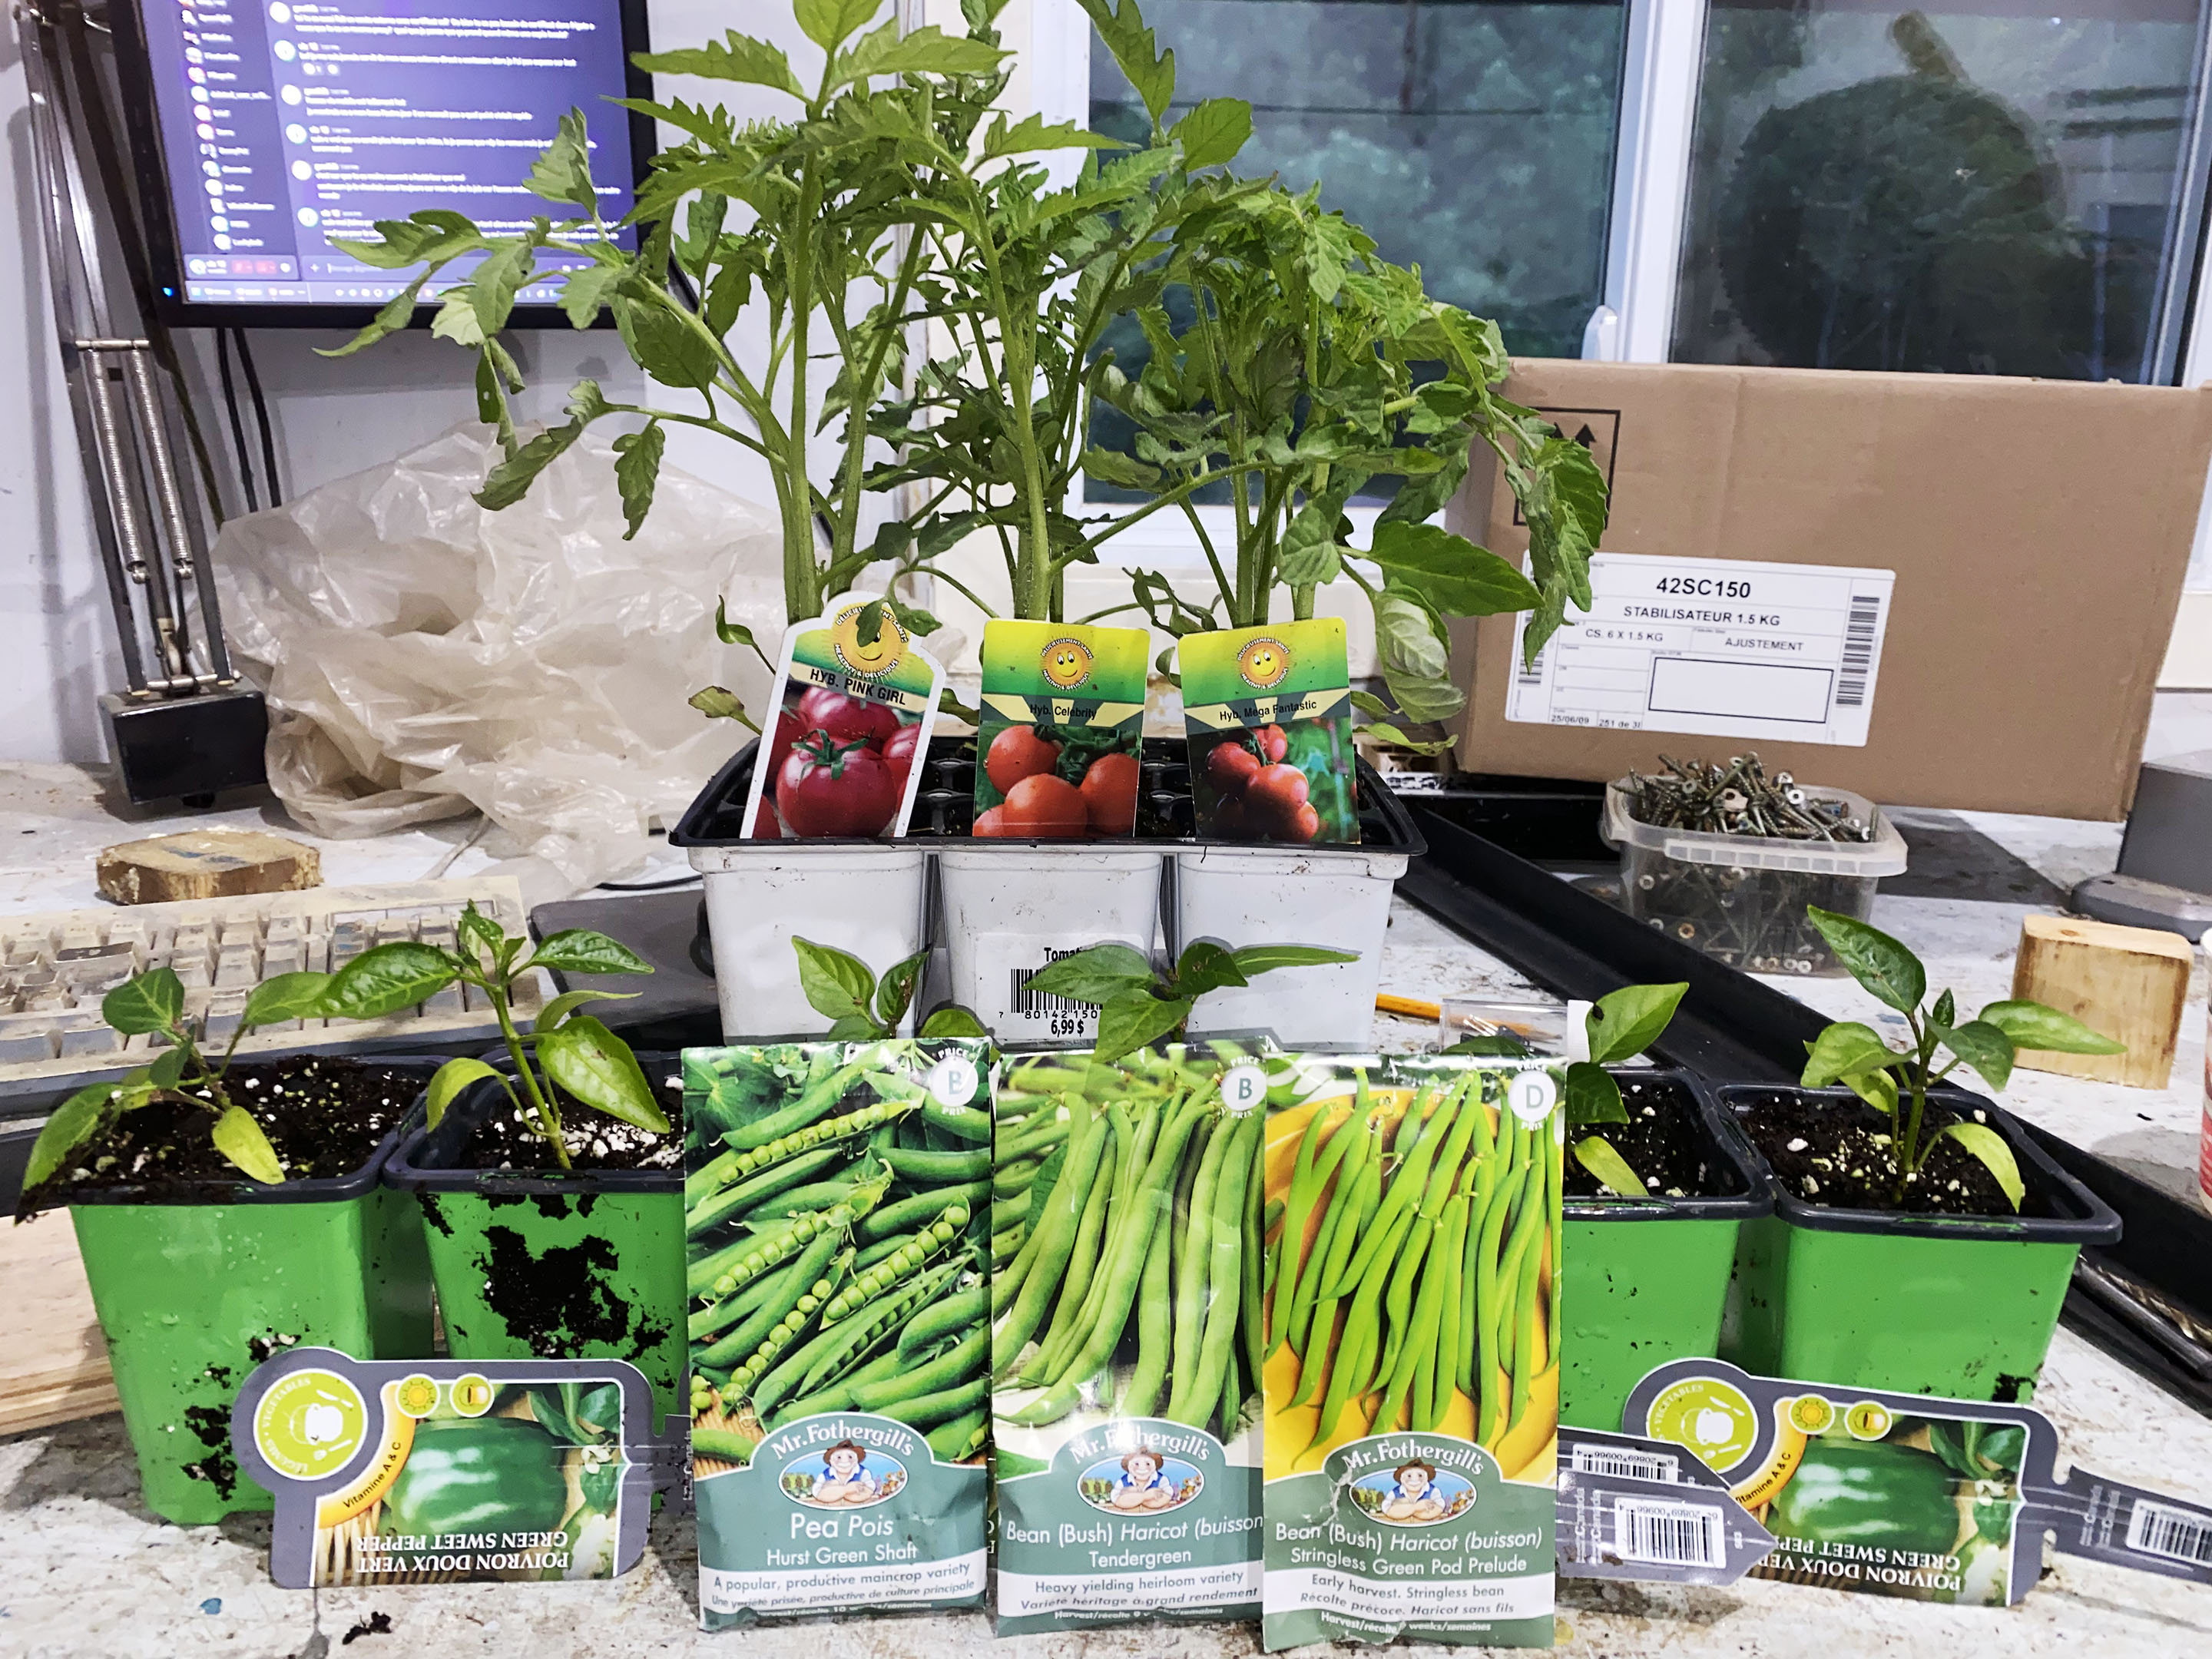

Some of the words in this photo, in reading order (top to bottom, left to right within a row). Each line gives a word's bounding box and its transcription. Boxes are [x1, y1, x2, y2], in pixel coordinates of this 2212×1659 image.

[1656, 577, 1752, 598] 42SC150
[1623, 605, 1732, 623] STABILISATEUR
[1737, 614, 1756, 624] 1.5
[1759, 615, 1780, 626] KG
[1585, 628, 1604, 638] CS.
[1608, 630, 1614, 638] 6
[1618, 631, 1624, 639] X
[1629, 631, 1643, 641] 1.5
[1647, 632, 1663, 642] KG
[1725, 637, 1804, 651] AJUSTEMENT
[834, 643, 856, 673] HEALTHY
[864, 658, 899, 678] DELICIOUS
[810, 668, 839, 687] HYB.
[844, 677, 875, 697] PINK
[877, 687, 906, 705] GIRL
[1029, 704, 1051, 717] Hyb.
[1054, 705, 1097, 720] Celebrity
[1220, 709, 1241, 721] Hyb.
[1244, 707, 1270, 719] Mega
[1273, 700, 1317, 714] Fantastic
[1551, 714, 1589, 724] 25/06/09
[1025, 1010, 1068, 1019] 80142
[1074, 1010, 1098, 1018] 150
[1051, 1019, 1075, 1038] 6,99
[1077, 1018, 1084, 1038] $
[937, 1047, 969, 1059] PRICE
[1230, 1055, 1260, 1068] PRICE
[1516, 1059, 1548, 1072] PRICE
[948, 1071, 963, 1094] B
[1238, 1078, 1253, 1100] B
[1525, 1084, 1545, 1108] D
[942, 1106, 967, 1117] PRIX
[1230, 1111, 1253, 1119] PRIX
[262, 1378, 311, 1428] VEGETABLES
[1654, 1382, 1704, 1425] VEGETABLES
[770, 1434, 808, 1460] Mr.
[806, 1419, 915, 1457] Fothergill's
[1069, 1439, 1106, 1465] Mr.
[1341, 1449, 1377, 1471] Mr.
[1376, 1438, 1485, 1476] Fothergill's
[1594, 1451, 1623, 1460] 00966
[1628, 1454, 1657, 1465] 20869
[343, 1472, 385, 1508] Vitamine
[383, 1463, 392, 1472] A
[388, 1453, 396, 1462] &
[392, 1441, 401, 1450] C
[1771, 1470, 1780, 1479] A
[1782, 1452, 1790, 1461] C
[790, 1512, 839, 1539] Pea
[847, 1514, 894, 1537] Pois
[1007, 1520, 1051, 1544] Bean
[1058, 1522, 1114, 1548] (Bush)
[1120, 1520, 1189, 1542] Haricot
[1194, 1515, 1263, 1541] (buisson
[356, 1535, 426, 1551] PEPPER
[430, 1533, 497, 1550] SWEET
[502, 1531, 568, 1548] GREEN
[1275, 1522, 1321, 1541] Bean
[1329, 1523, 1382, 1555] (Bush)
[1389, 1533, 1459, 1552] Haricot
[1465, 1526, 1542, 1553] (buisson)
[1777, 1535, 1815, 1555] PEP
[412, 1555, 471, 1571] DOUX
[475, 1552, 568, 1571] POIVRON
[767, 1548, 810, 1566] Hurst
[815, 1547, 868, 1565] Green
[874, 1543, 918, 1561] Shaft
[1088, 1549, 1192, 1571] Tendergreen
[1290, 1546, 1366, 1571] Stringless
[1373, 1558, 1425, 1576] Green
[1431, 1557, 1462, 1575] Pod
[1468, 1555, 1527, 1574] Prelude
[1819, 1541, 1887, 1564] SWEET
[1891, 1548, 1961, 1571] GREEN
[356, 1556, 407, 1573] VERT
[1801, 1558, 1862, 1580] DOUX
[714, 1576, 722, 1589] A
[726, 1576, 781, 1594] popular,
[786, 1571, 856, 1591] productive
[860, 1568, 922, 1586] maincrop
[926, 1562, 970, 1580] variety
[1035, 1581, 1077, 1597] Heavy
[1082, 1579, 1134, 1595] yielding
[1139, 1576, 1195, 1590] heirloom
[1200, 1571, 1243, 1587] variety
[1312, 1574, 1345, 1591] Early
[1349, 1578, 1402, 1600] harvest.
[1406, 1586, 1468, 1601] Stringless
[1472, 1585, 1505, 1598] bean
[1866, 1565, 1961, 1591] POIVRON
[712, 1594, 728, 1607] Une
[809, 1590, 866, 1604] productive
[869, 1589, 882, 1598] de
[885, 1586, 920, 1598] culture
[923, 1579, 975, 1597] principale
[1021, 1597, 1068, 1610] Variété
[1072, 1595, 1128, 1608] héritage
[1146, 1593, 1185, 1608] grand
[1189, 1587, 1258, 1601] rendement
[1300, 1591, 1348, 1608] Récolte
[1410, 1605, 1459, 1615] Haricot
[1462, 1604, 1491, 1614] sans
[1495, 1601, 1515, 1613] fils
[1409, 1621, 1492, 1632] weeks/semaines
